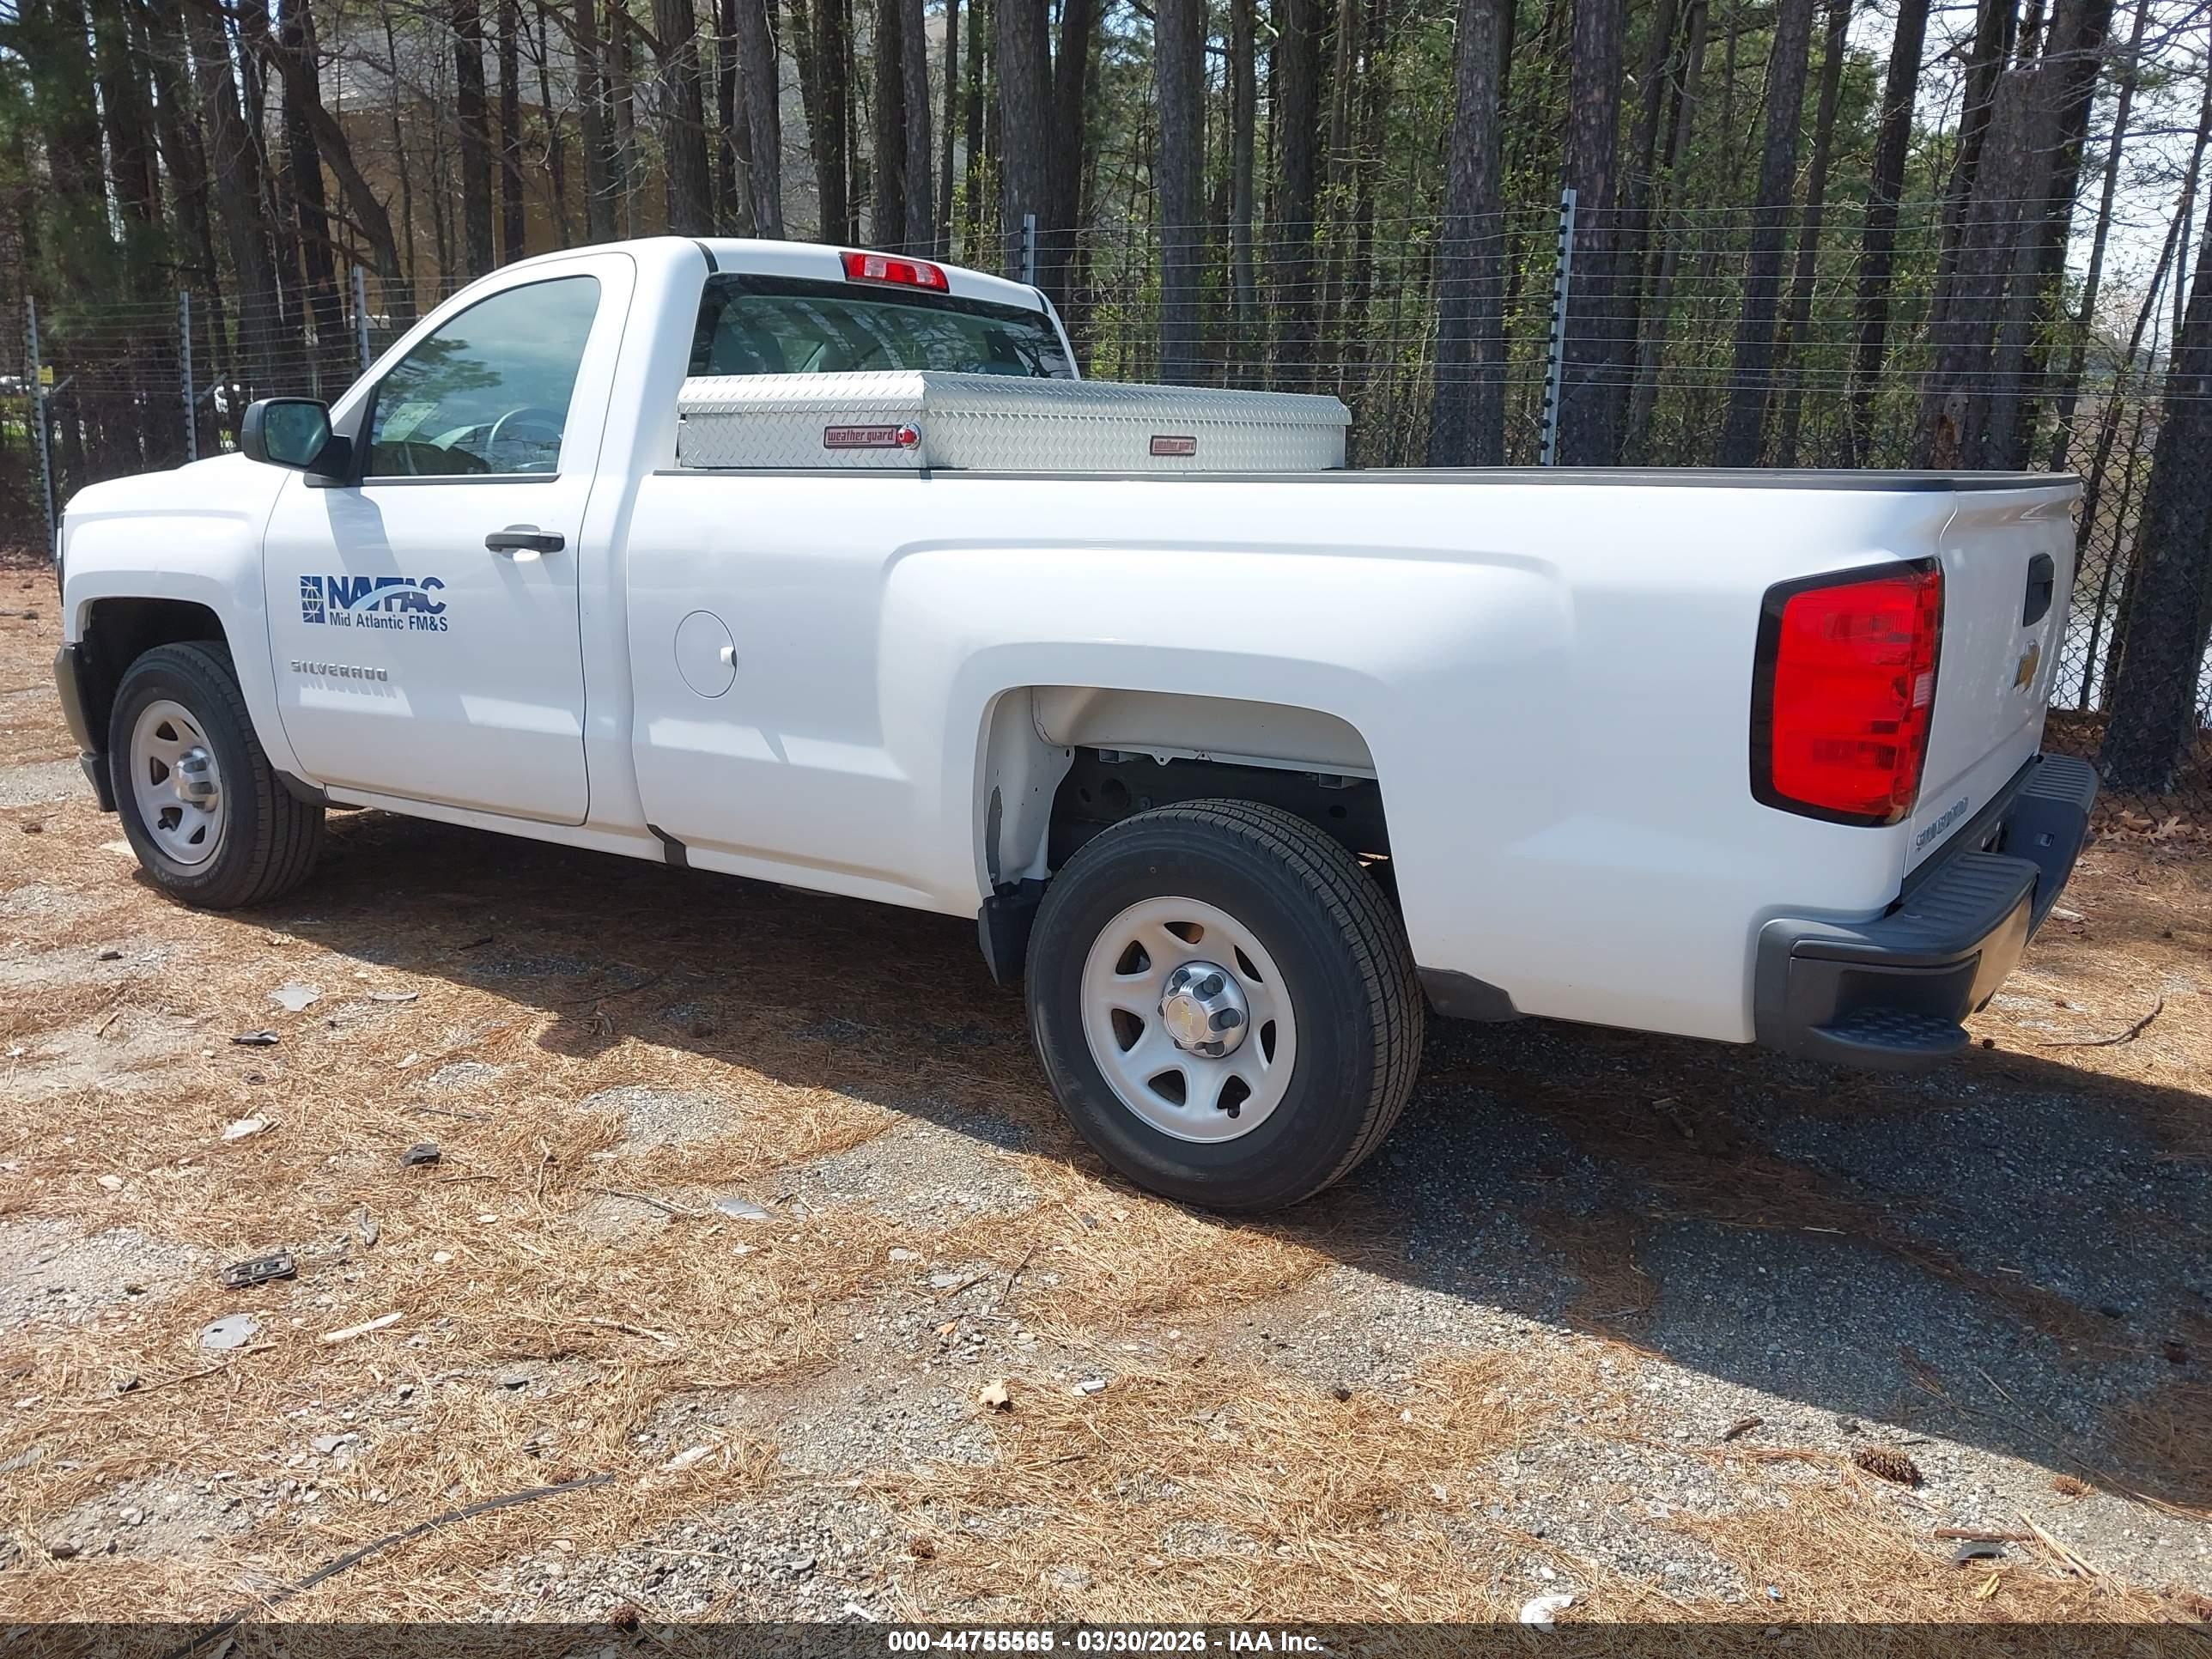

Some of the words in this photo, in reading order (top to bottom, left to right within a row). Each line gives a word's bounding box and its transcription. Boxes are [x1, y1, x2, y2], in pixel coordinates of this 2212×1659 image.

[828, 429, 865, 441] weather
[866, 429, 894, 443] guard
[329, 612, 351, 627] Mid
[356, 613, 404, 630] Atlantic
[409, 615, 448, 632] FM&S
[291, 659, 388, 682] SILVERADO
